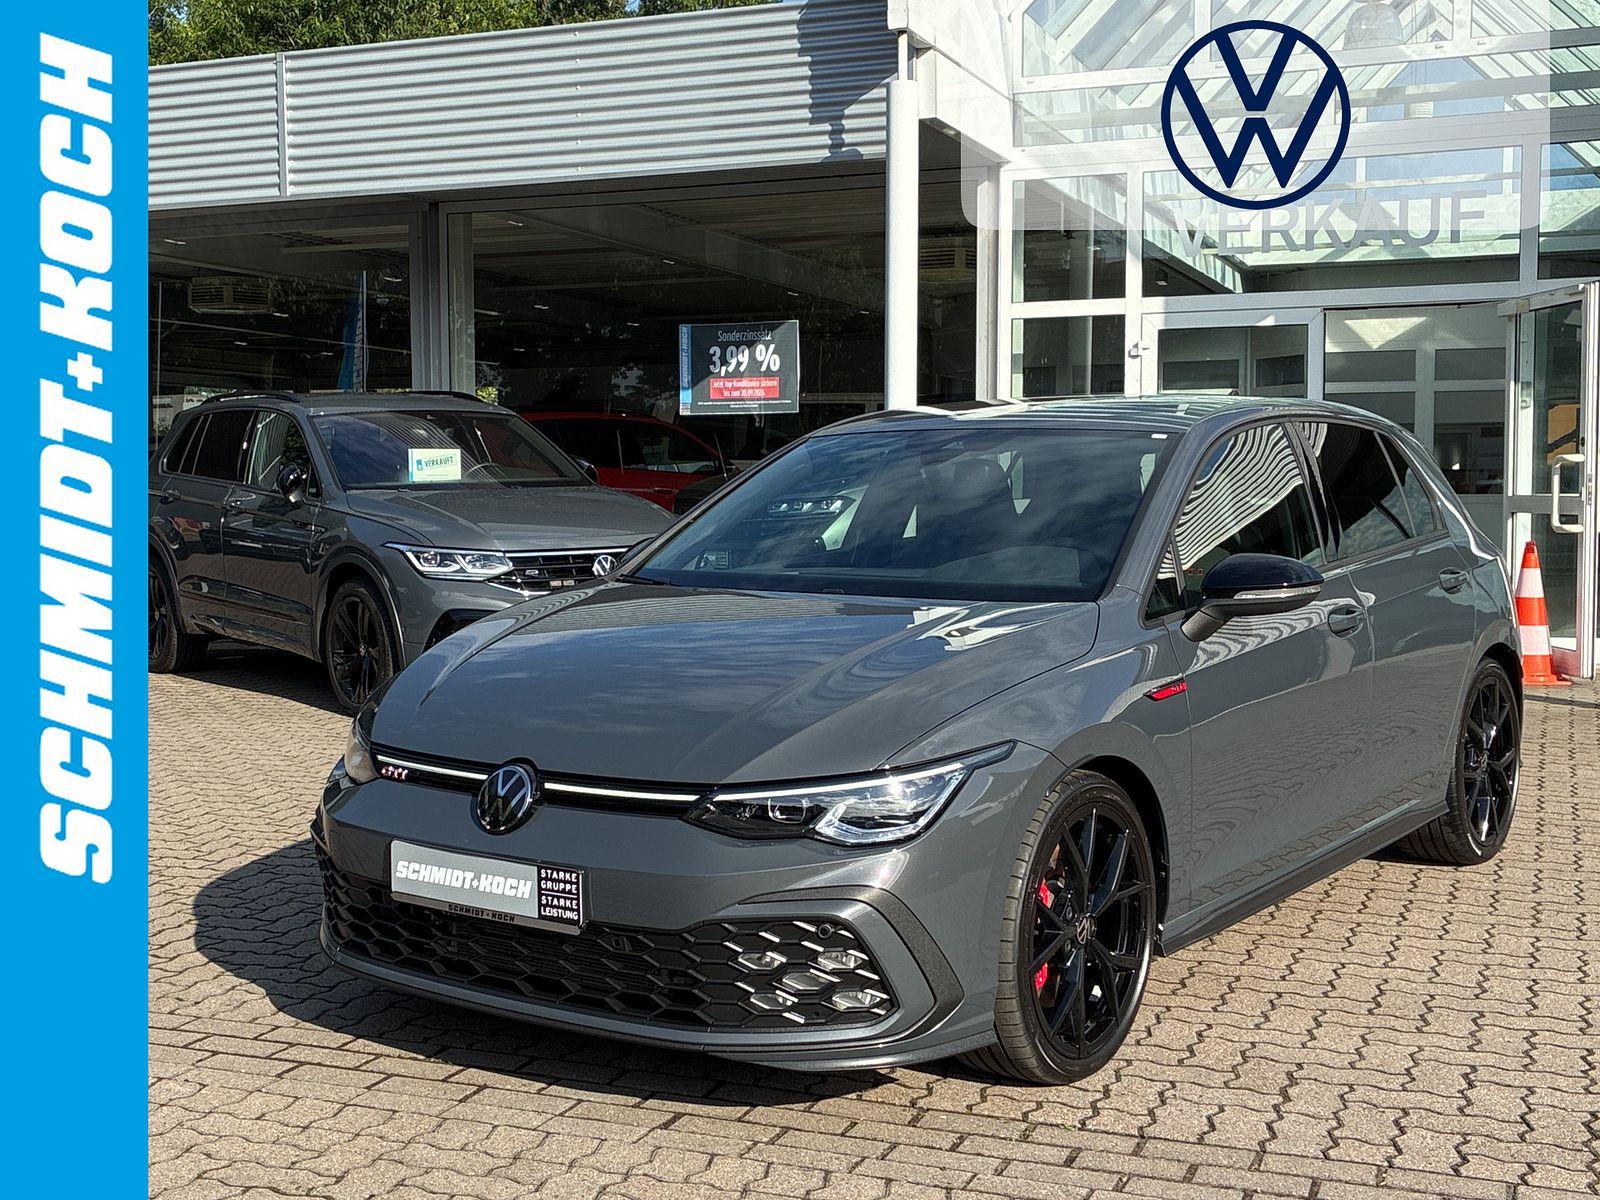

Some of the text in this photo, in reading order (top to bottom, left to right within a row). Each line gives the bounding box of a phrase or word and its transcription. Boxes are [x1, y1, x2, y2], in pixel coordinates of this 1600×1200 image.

[1173, 189, 1487, 258] VERKAUF
[717, 329, 772, 342] Sonderzinssatz
[709, 343, 781, 377] 3,99 %
[424, 456, 454, 468] VERKAUFT
[395, 860, 533, 899] SCHMIDT+KOCH
[540, 868, 578, 882] STARKE
[540, 880, 578, 894] GRUPPE
[541, 895, 578, 909] STARKE
[540, 906, 579, 920] LEISTUNG
